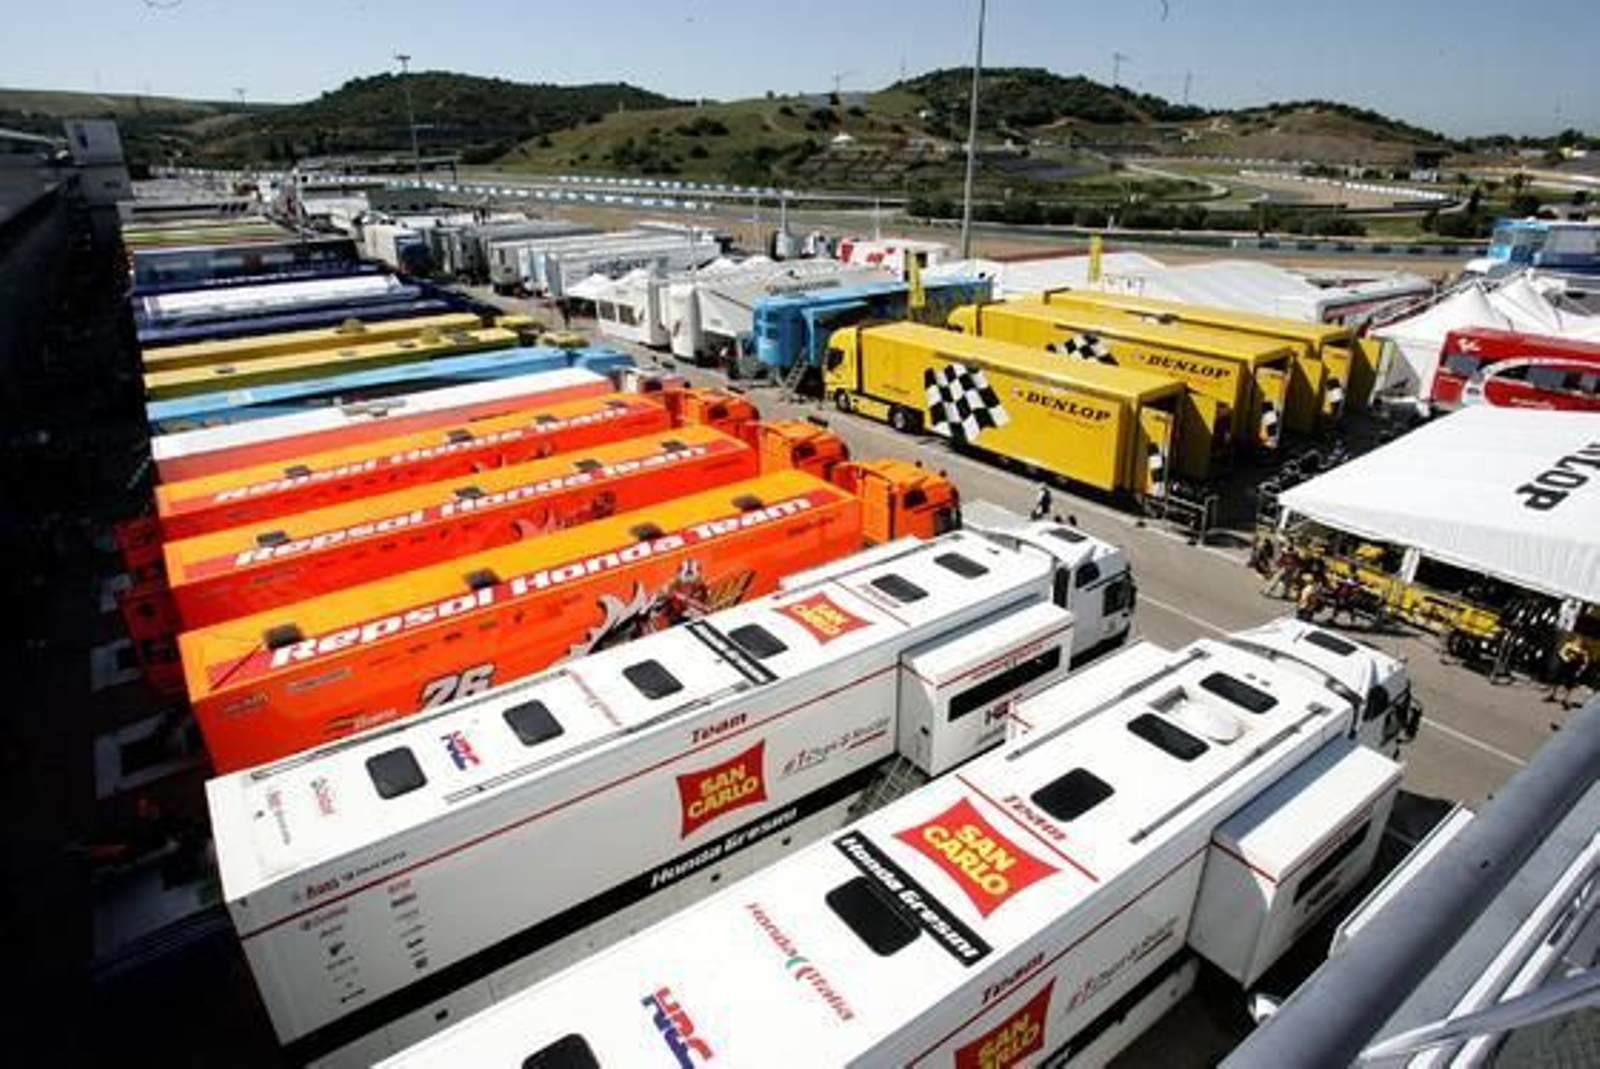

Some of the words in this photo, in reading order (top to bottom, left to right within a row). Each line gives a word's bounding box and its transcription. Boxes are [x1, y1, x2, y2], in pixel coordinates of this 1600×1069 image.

[1149, 354, 1231, 380] DUNLOP
[1026, 391, 1111, 421] DUNLOP
[235, 509, 423, 567] Repsol
[440, 473, 594, 517] Honda
[603, 447, 707, 475] Team
[270, 587, 494, 669] Repsol
[510, 533, 686, 596] Honda
[692, 498, 812, 539] Team
[419, 660, 497, 710] 26
[689, 712, 749, 744] Team
[687, 776, 759, 818] CARLO
[699, 764, 747, 797] SAN
[1003, 795, 1068, 841] Team
[650, 842, 723, 887] Honda
[724, 807, 798, 853] Gresini
[922, 824, 1010, 896] CARLO
[955, 824, 1016, 871] SAN
[841, 837, 905, 892] Honda
[898, 889, 981, 958] Gresini
[745, 902, 799, 957] Honda
